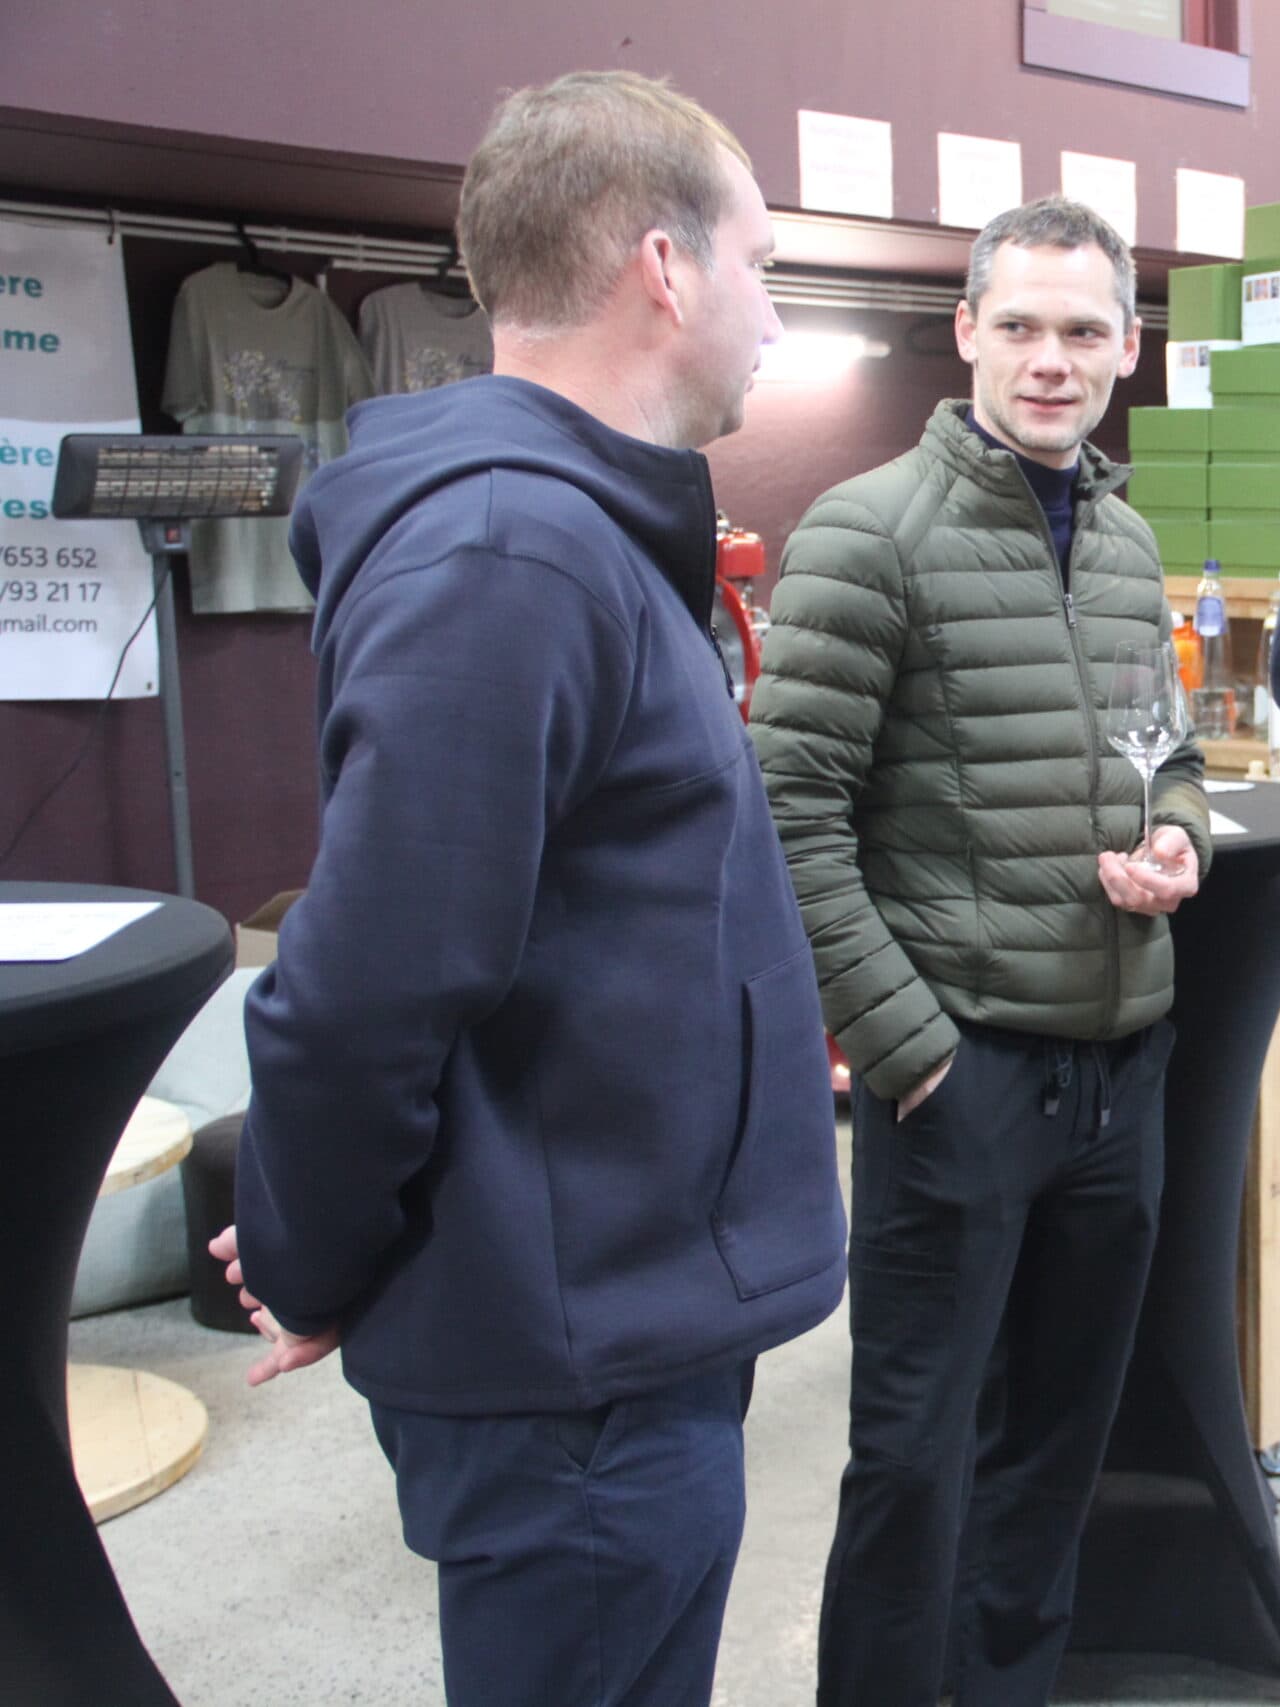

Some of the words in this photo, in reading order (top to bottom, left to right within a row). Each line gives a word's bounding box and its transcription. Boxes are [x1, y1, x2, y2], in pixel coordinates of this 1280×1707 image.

[0, 438, 53, 466] ère
[56, 547, 97, 569] 652
[0, 580, 38, 602] /93
[47, 582, 70, 602] 21
[78, 582, 102, 602] 17
[0, 613, 98, 634] mail.com
